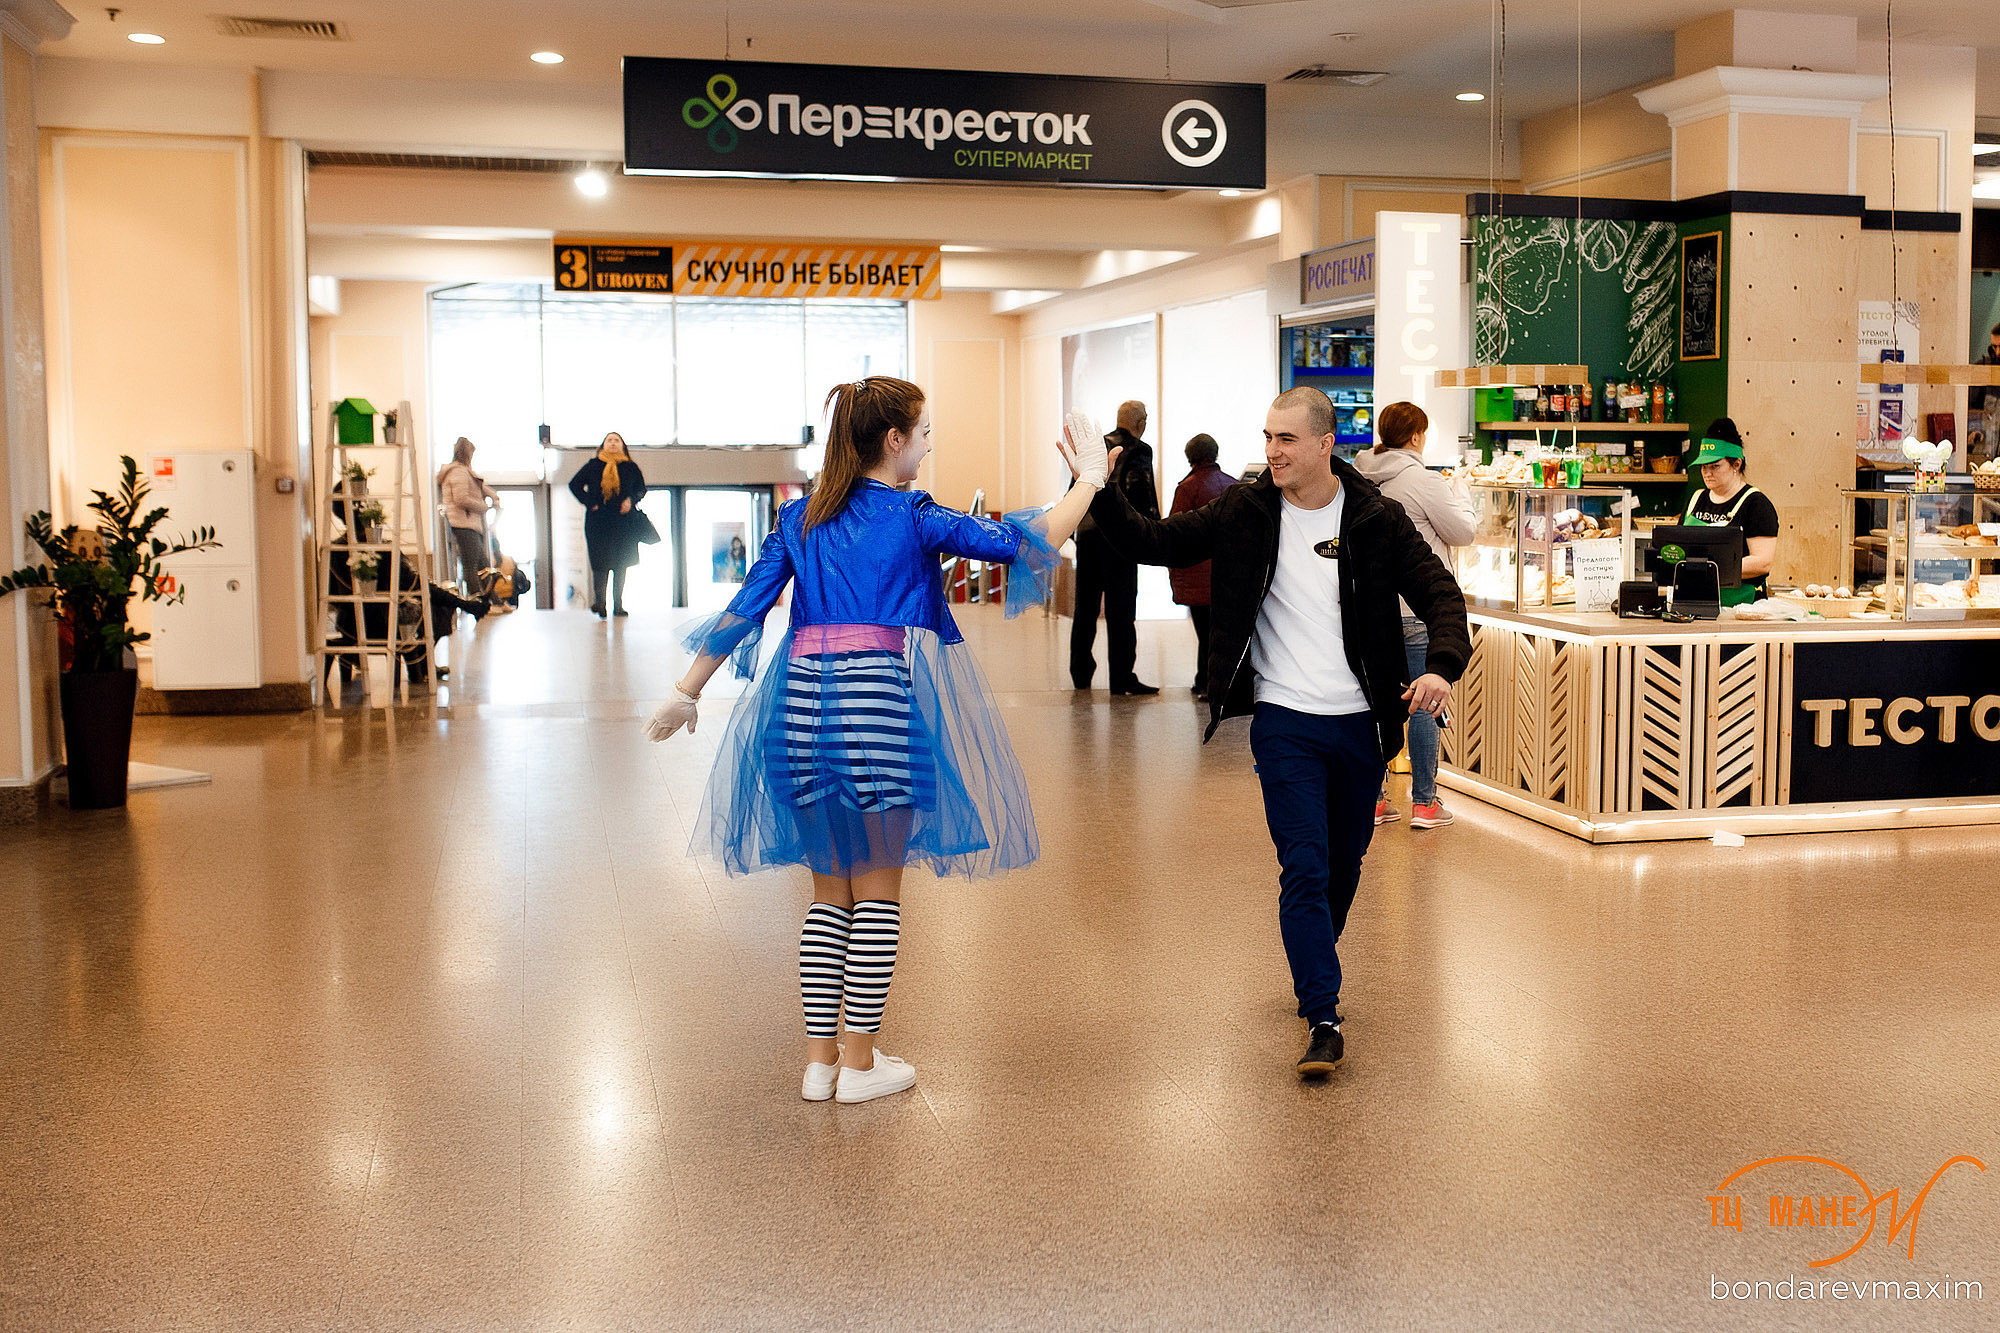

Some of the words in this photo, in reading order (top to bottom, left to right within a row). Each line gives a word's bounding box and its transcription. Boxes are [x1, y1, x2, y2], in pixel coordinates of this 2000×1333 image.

[768, 93, 1092, 151] Перекресток
[954, 149, 1093, 171] СУПЕРМАРКЕТ
[560, 249, 588, 288] 3
[596, 272, 668, 289] UROVEN
[687, 260, 785, 284] СКУЧНО
[793, 262, 820, 284] НЕ
[828, 263, 924, 287] БЫВАЕТ
[1860, 311, 1892, 320] ТЕСТО
[1400, 222, 1442, 452] ТЕСТ
